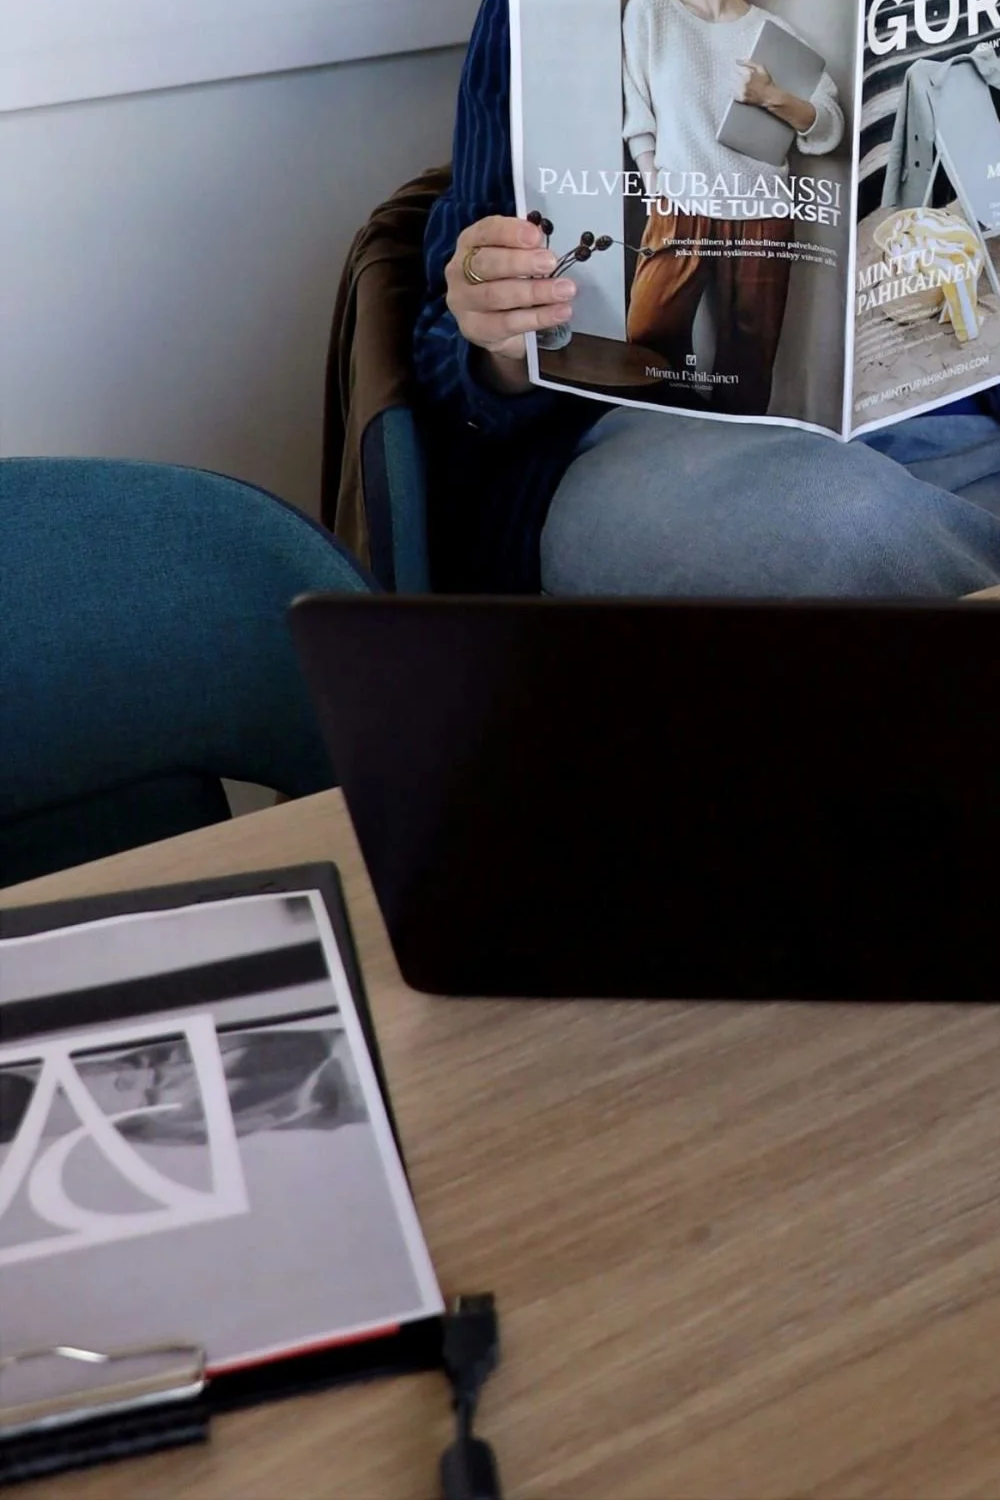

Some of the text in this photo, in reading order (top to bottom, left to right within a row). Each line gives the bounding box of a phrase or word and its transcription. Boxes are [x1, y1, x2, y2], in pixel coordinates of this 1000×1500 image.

[538, 166, 842, 209] PALVELUBALANSSI
[641, 198, 842, 228] TUNNE TULOKSET
[856, 258, 981, 316] PAHIKAINEN
[858, 247, 936, 292] MINTTU
[645, 366, 739, 384] Minttu Pahikainen
